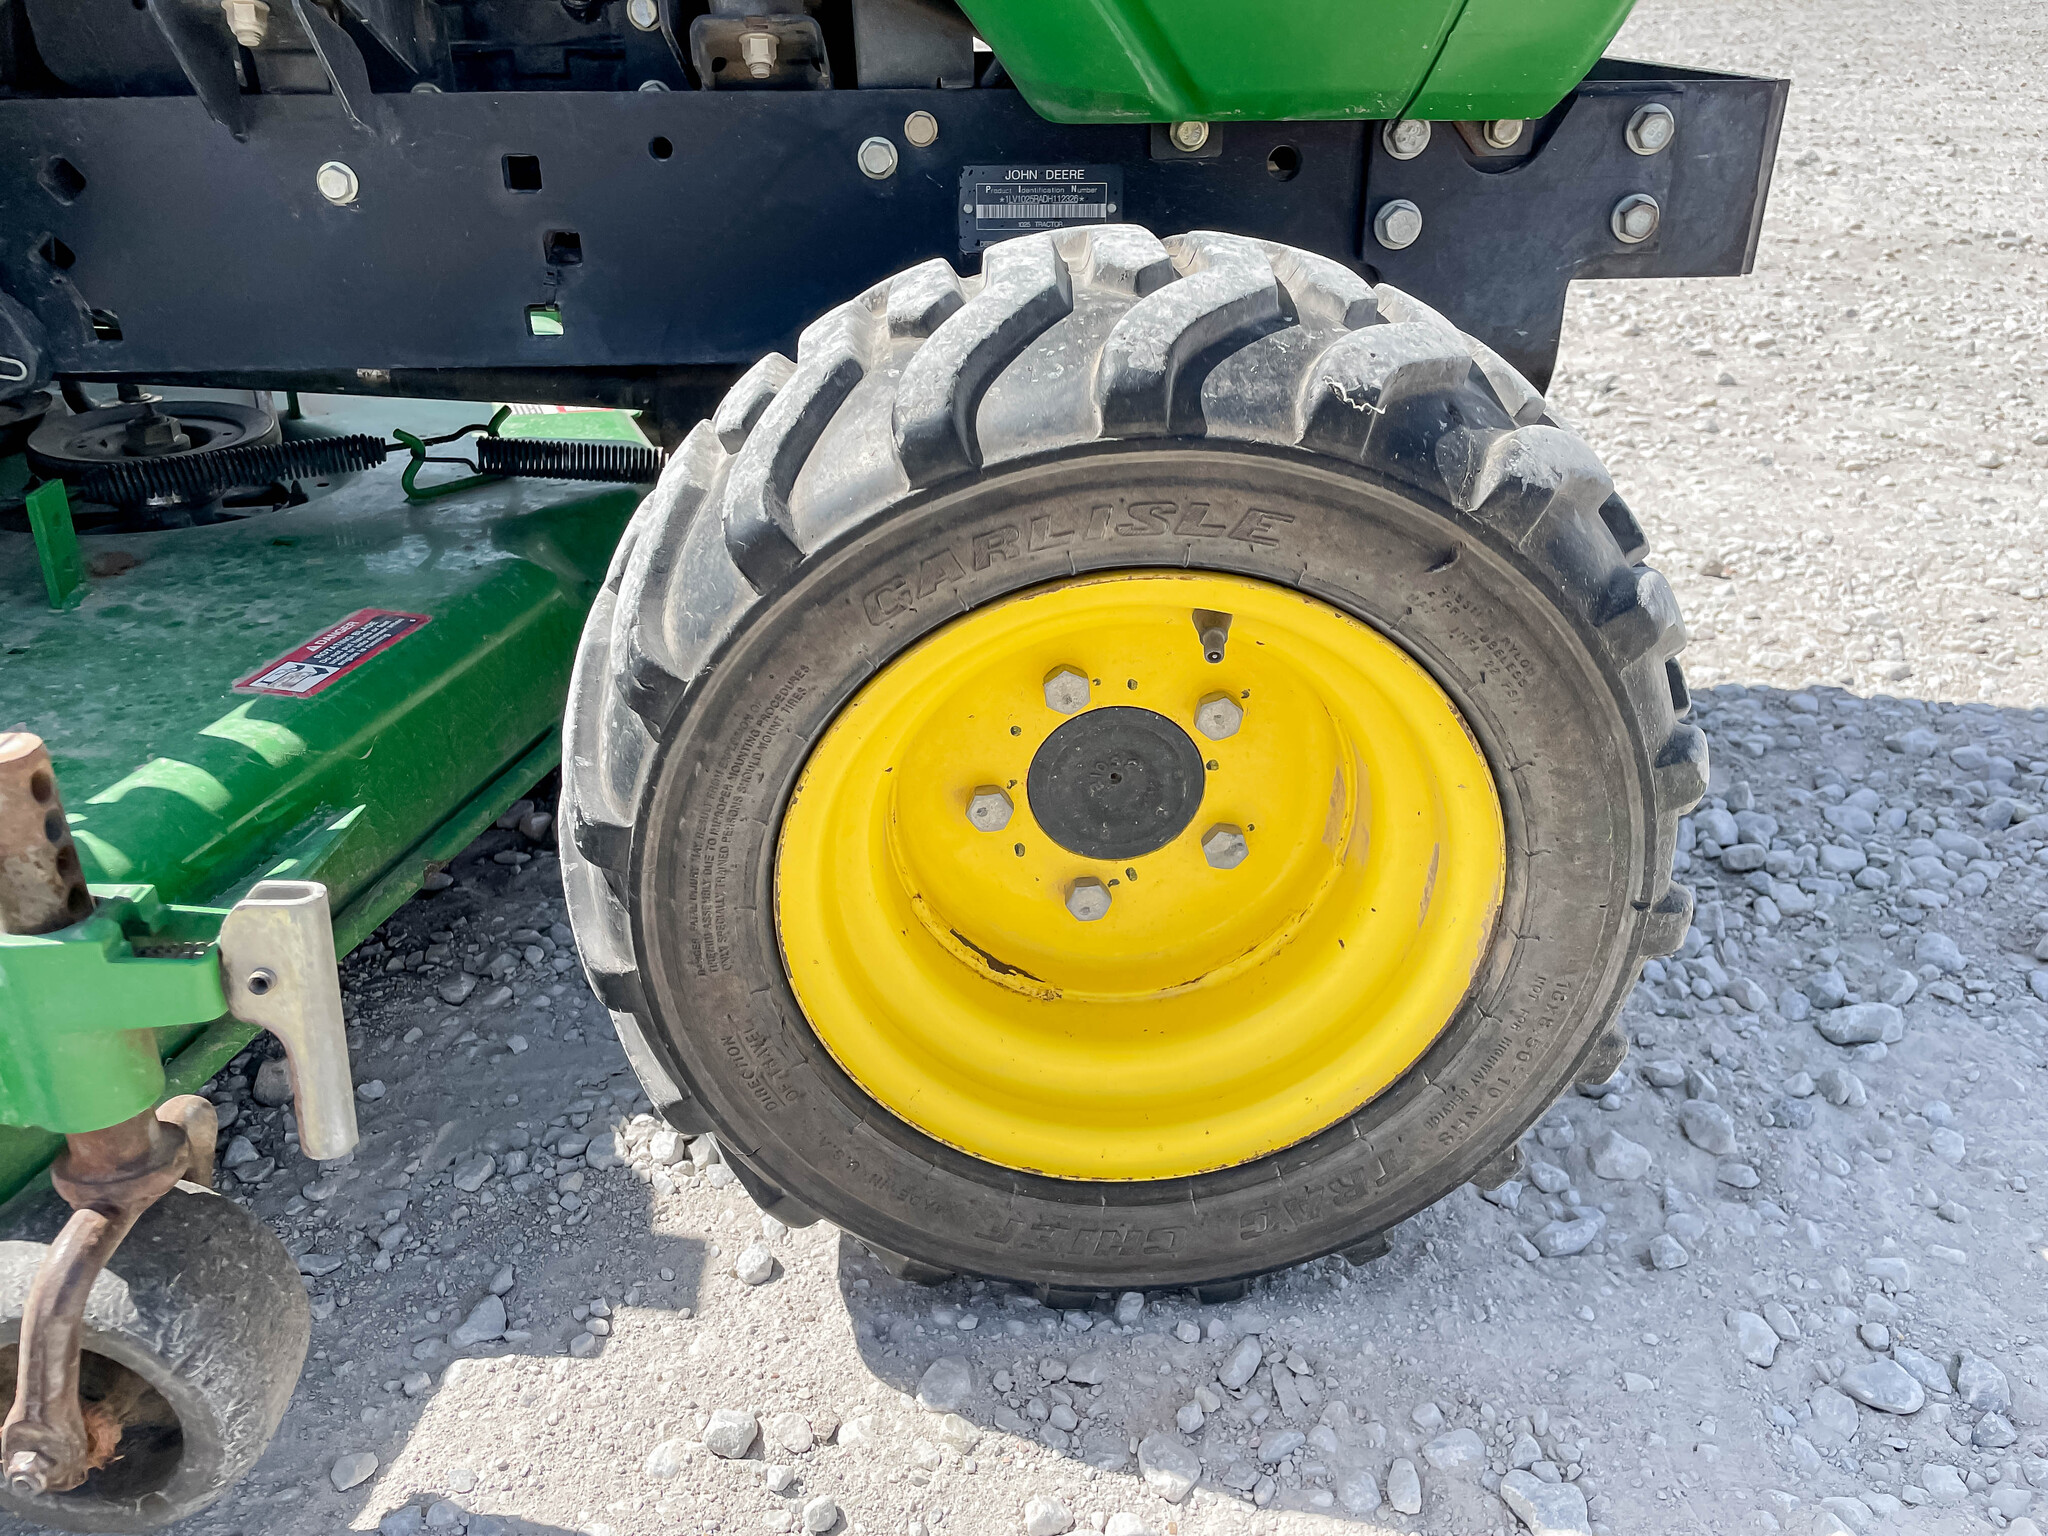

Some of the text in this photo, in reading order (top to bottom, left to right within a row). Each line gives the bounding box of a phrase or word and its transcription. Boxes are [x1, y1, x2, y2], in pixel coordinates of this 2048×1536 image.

[985, 185, 1098, 194] Product Identification Number
[1004, 169, 1085, 180] JOHN DEERE
[862, 502, 1296, 626] CARLISLE
[314, 621, 360, 645] DANGER
[755, 663, 811, 727] PROCEDURES
[780, 685, 808, 714] TIRES
[755, 714, 785, 751] MOUNT
[726, 728, 761, 780] MOUNTING
[736, 751, 763, 793] SHOULD
[708, 783, 733, 835] IMPROPER
[720, 794, 744, 843] PERSONS
[701, 854, 714, 874] DUE
[705, 837, 717, 850] TO
[715, 845, 729, 887] TRAINED
[1525, 974, 1546, 1002] NOT
[1509, 1008, 1530, 1031] FOR
[719, 1034, 779, 1112] DIRECTION
[1467, 1036, 1513, 1087] HIGHWAY
[974, 1148, 1411, 1256] TRAC CHIEF
